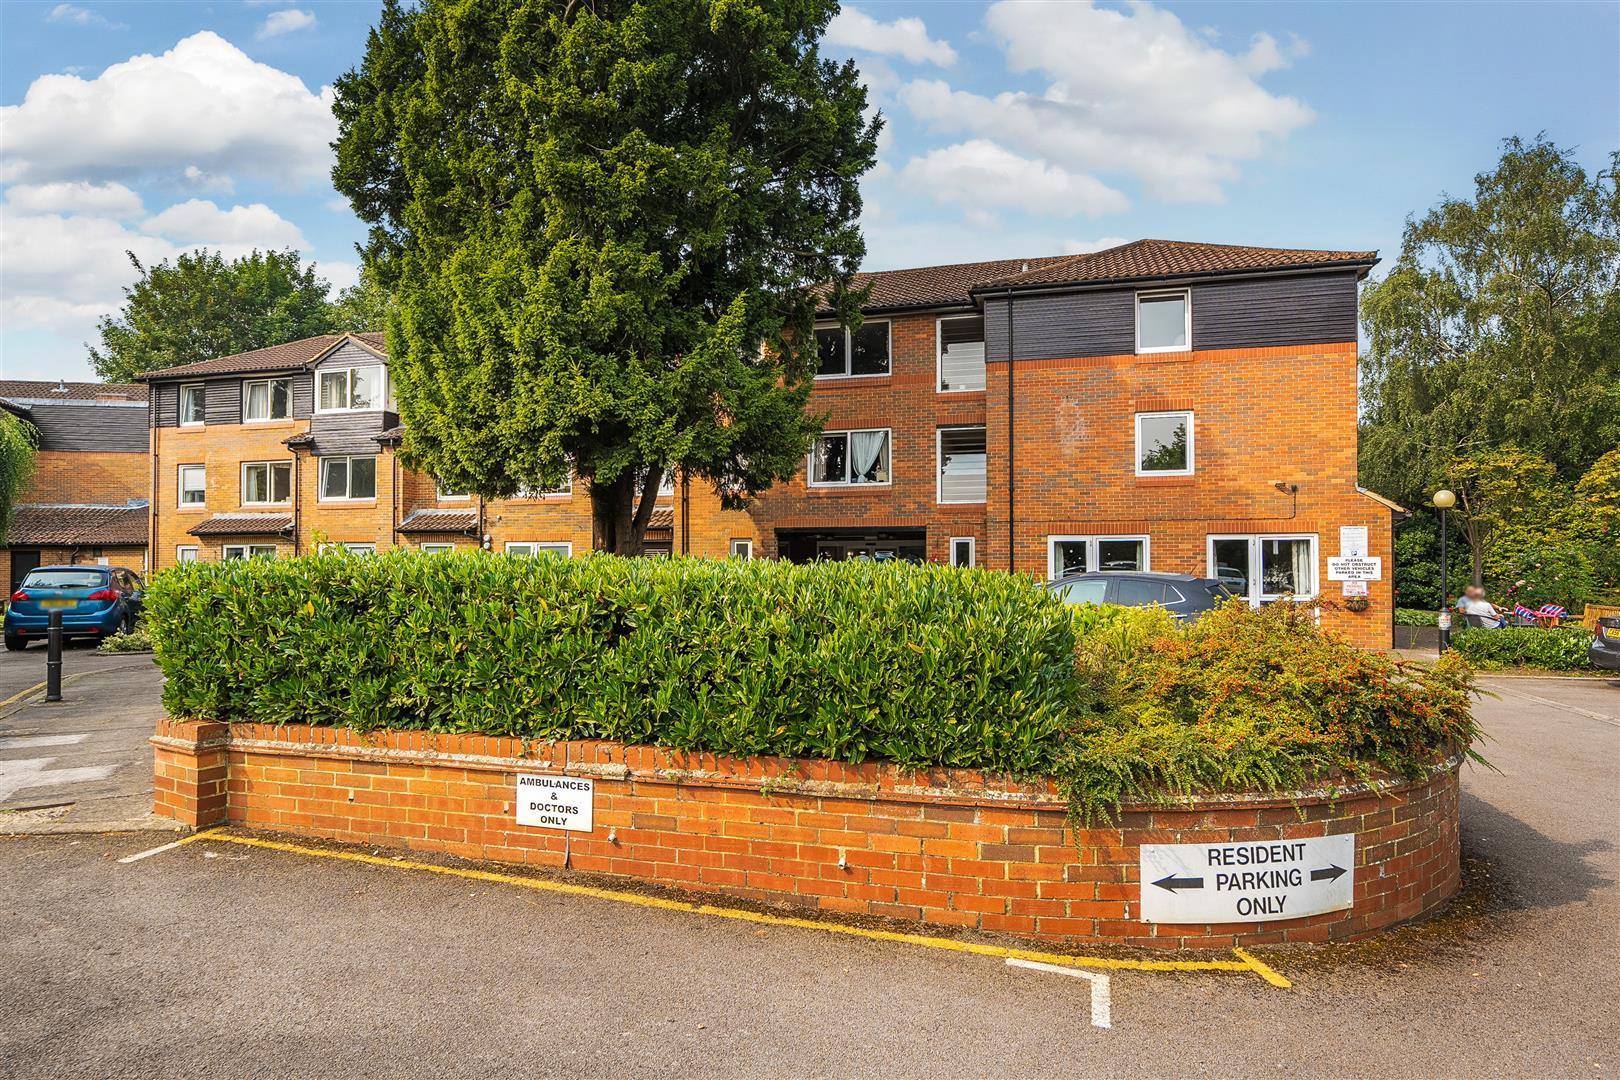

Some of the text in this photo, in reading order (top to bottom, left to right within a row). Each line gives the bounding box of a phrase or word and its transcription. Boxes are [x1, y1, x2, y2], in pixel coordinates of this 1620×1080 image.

[519, 777, 590, 791] AMBULANCES
[550, 792, 558, 801] &
[530, 802, 579, 815] DOCTORS
[540, 815, 567, 826] ONLY
[1208, 843, 1306, 866] RESIDENT
[1216, 868, 1302, 891] PARKING
[1236, 895, 1287, 916] ONLY
